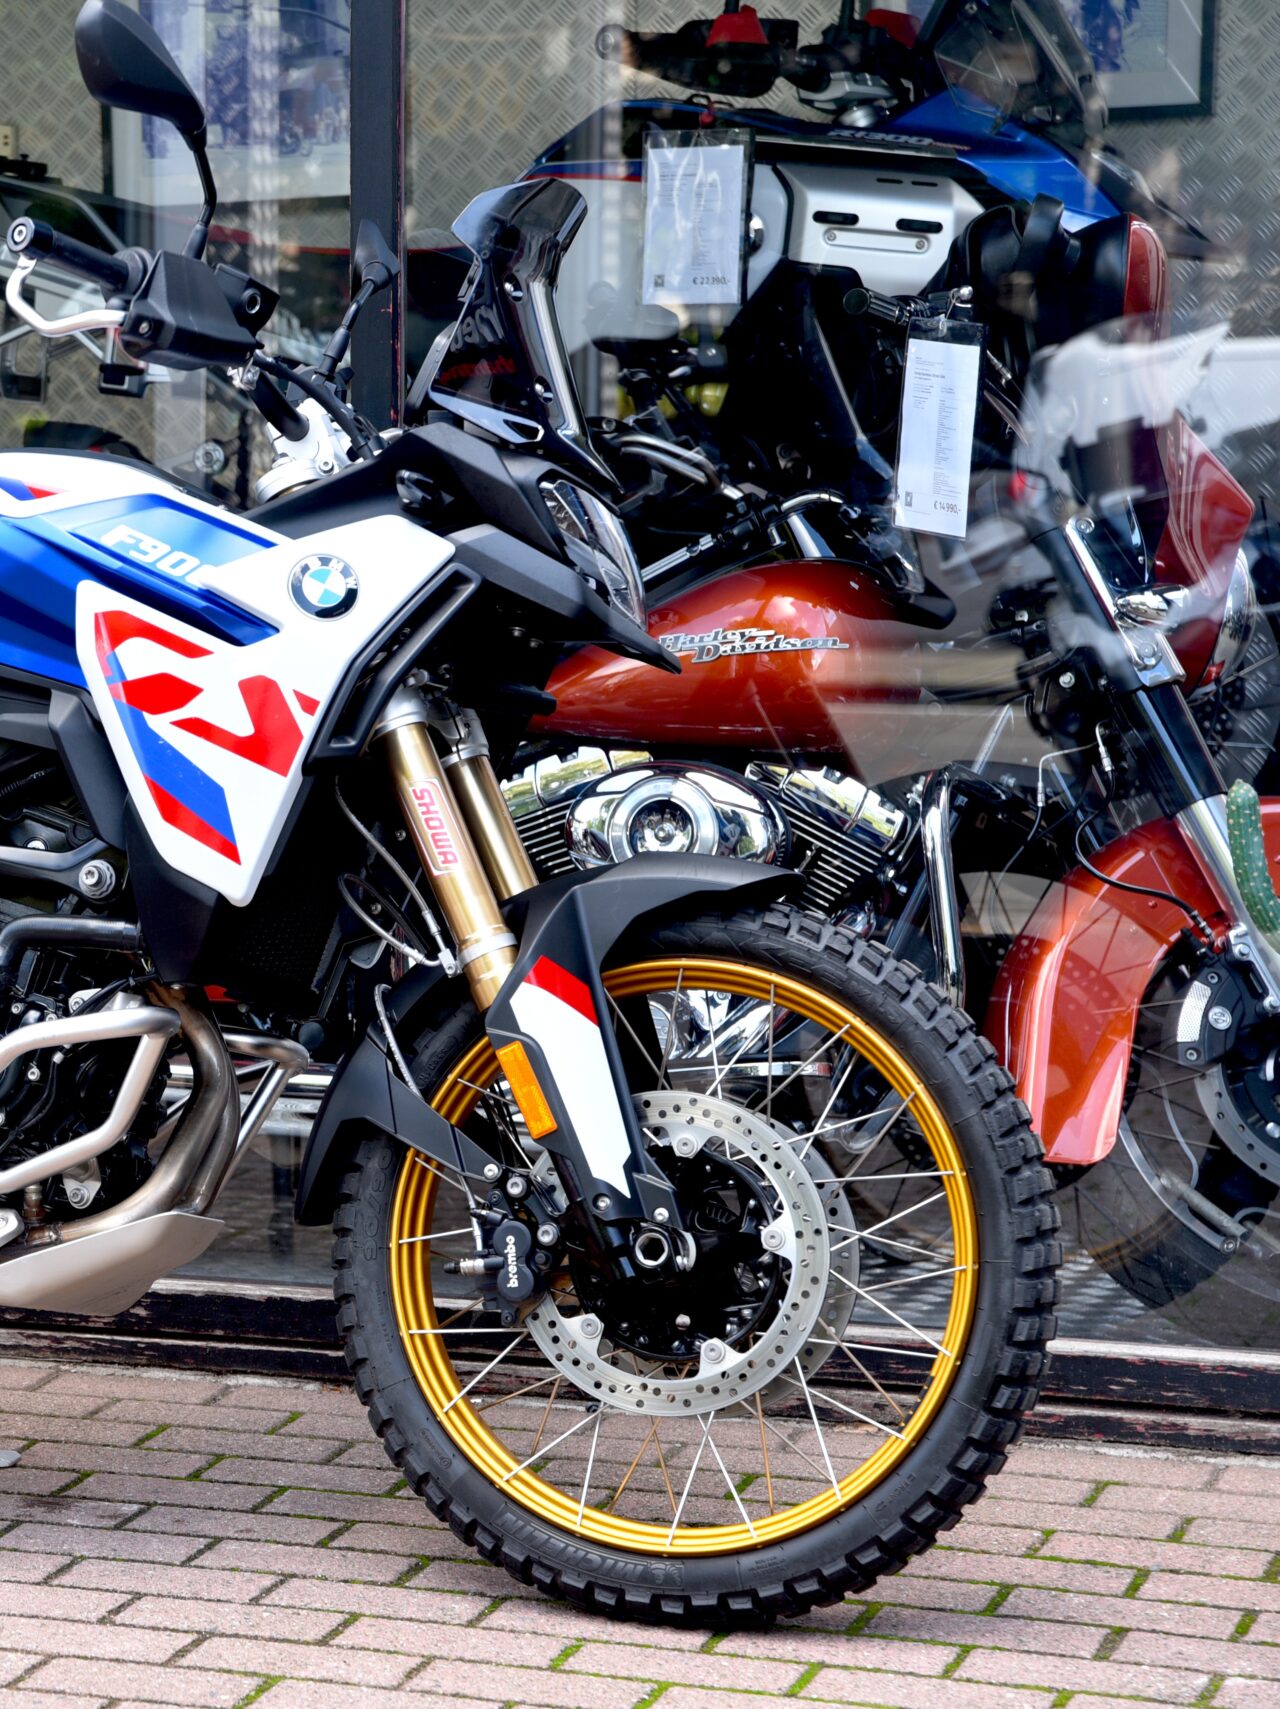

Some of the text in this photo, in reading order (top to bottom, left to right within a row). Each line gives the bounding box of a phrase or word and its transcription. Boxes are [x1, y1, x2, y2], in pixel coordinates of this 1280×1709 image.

[657, 627, 775, 653] Harley
[691, 634, 850, 664] Davidson
[411, 787, 459, 866] SHOWA
[504, 1235, 519, 1288] brembo
[495, 1509, 644, 1583] MICHELIN
